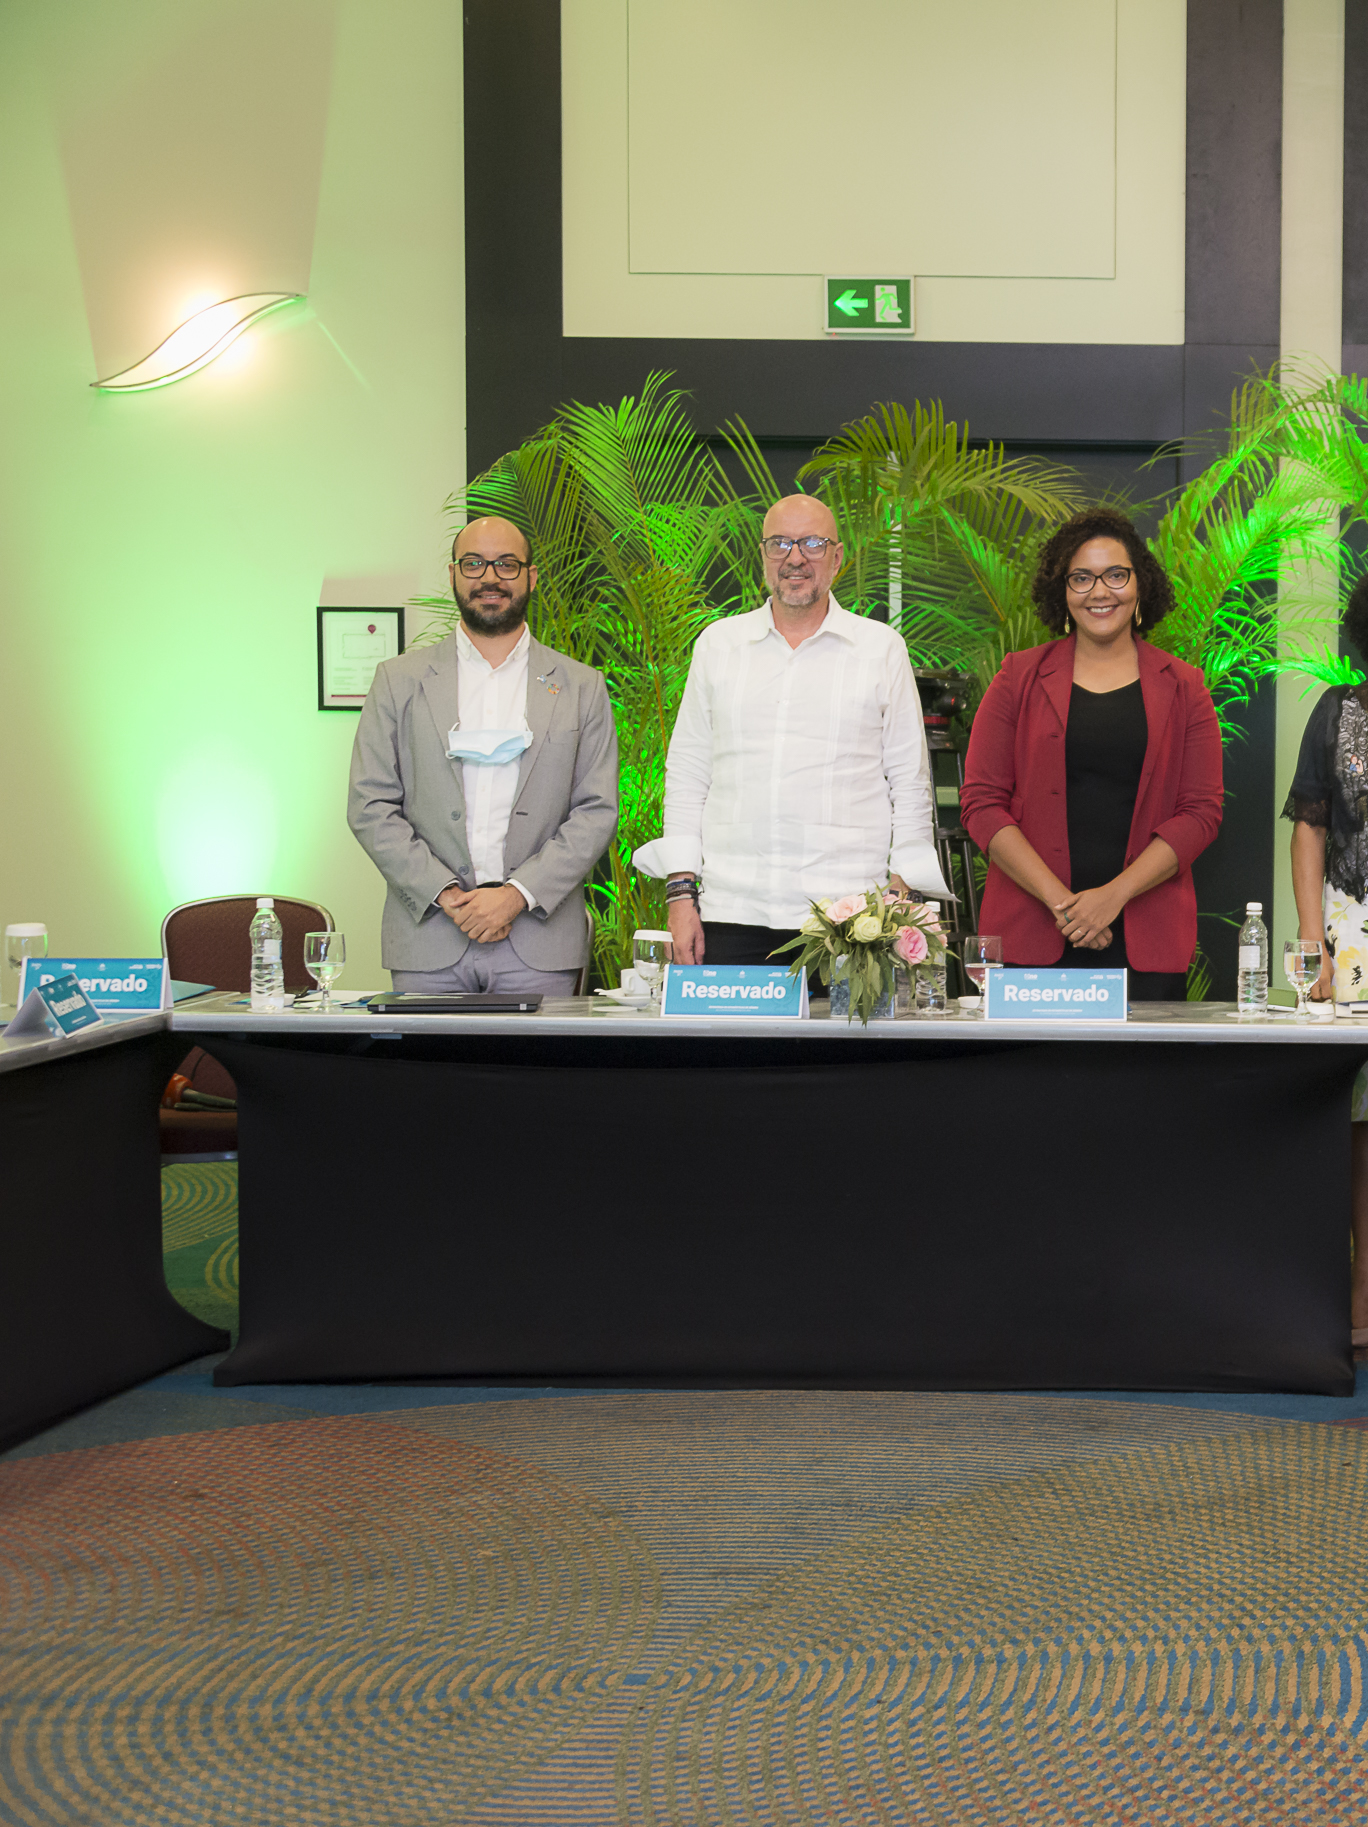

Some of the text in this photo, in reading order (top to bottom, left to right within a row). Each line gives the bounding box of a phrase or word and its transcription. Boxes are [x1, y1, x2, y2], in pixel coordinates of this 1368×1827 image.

[39, 974, 148, 993] Rervado
[681, 980, 787, 999] Reservado
[1003, 984, 1109, 1002] Reservado
